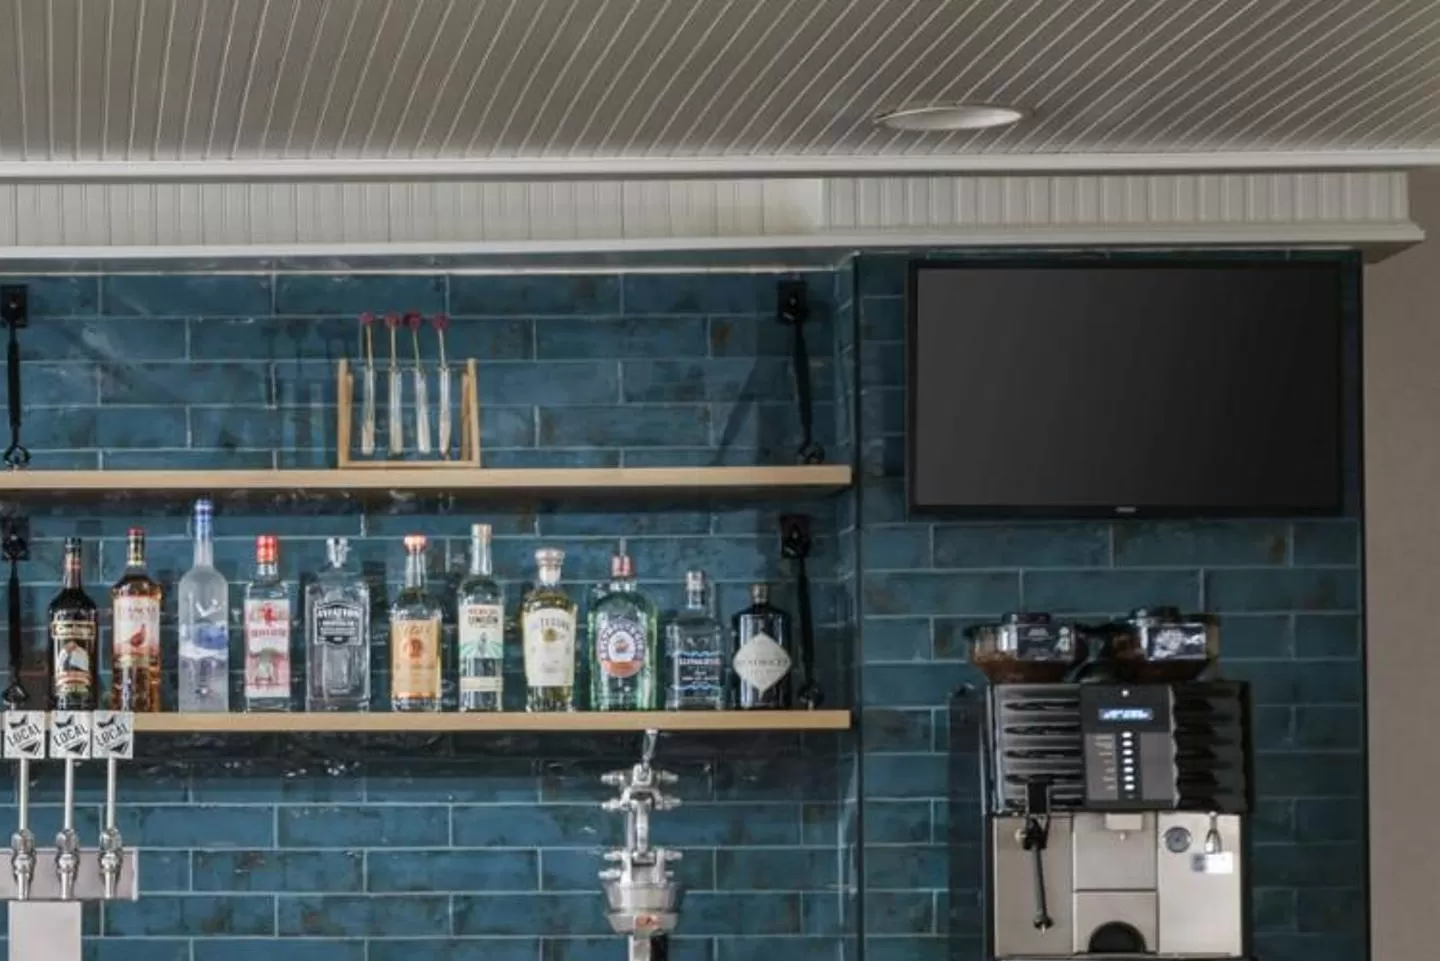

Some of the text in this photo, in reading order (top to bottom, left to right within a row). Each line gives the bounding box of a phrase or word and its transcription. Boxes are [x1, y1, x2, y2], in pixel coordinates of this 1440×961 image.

[7, 723, 42, 747] LOCAL
[53, 723, 88, 747] LOCAL
[95, 723, 129, 747] LOCAL
